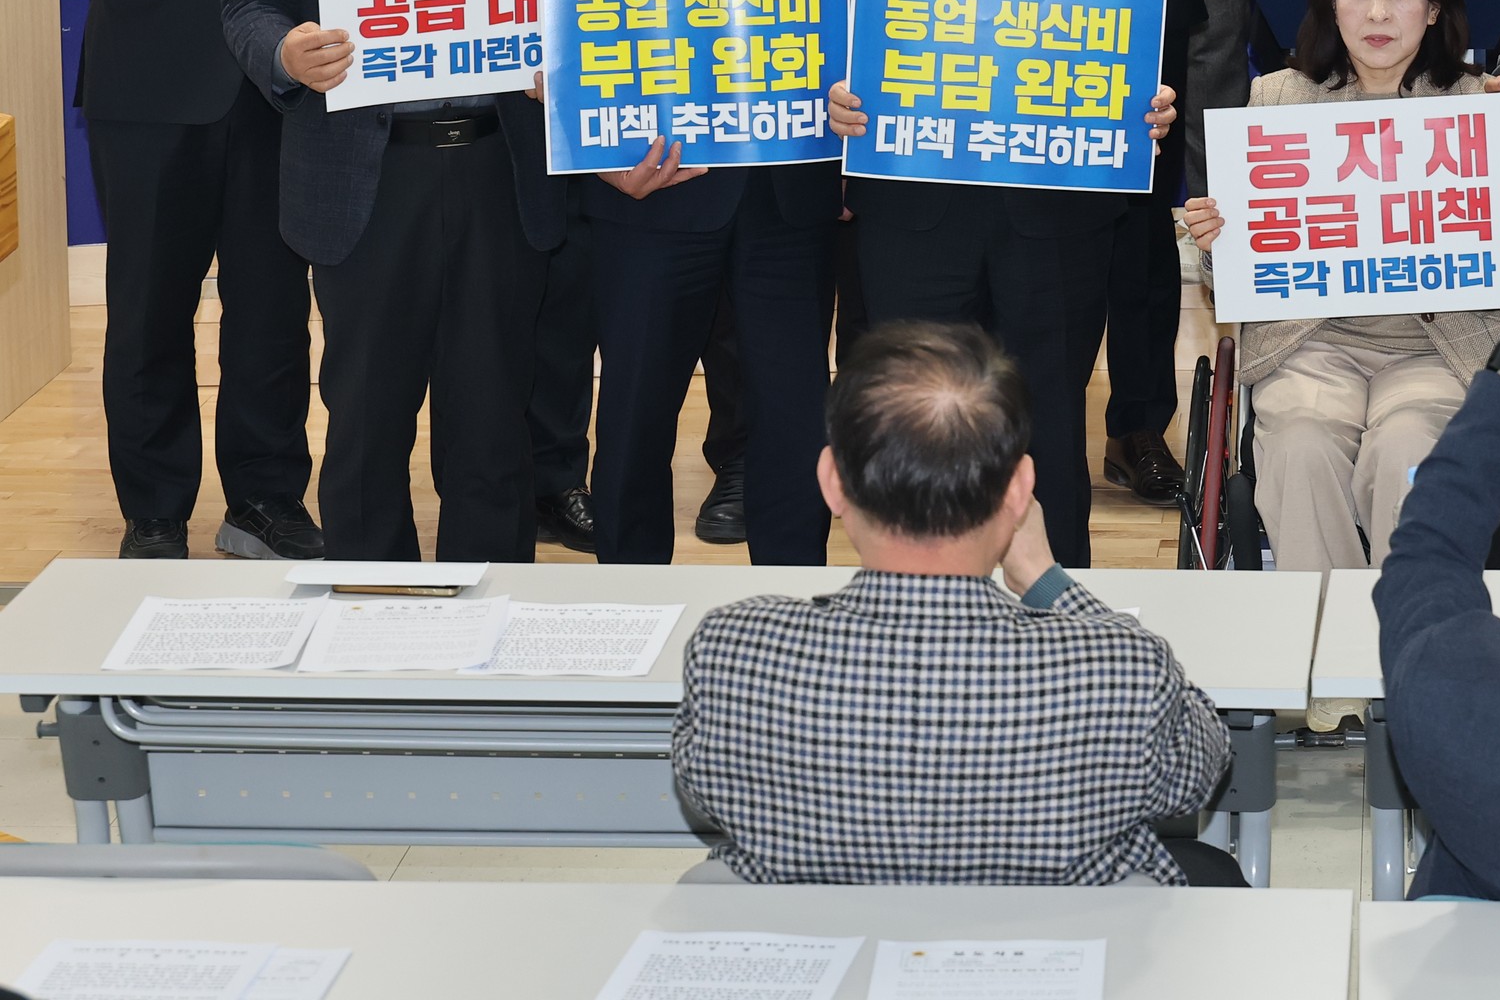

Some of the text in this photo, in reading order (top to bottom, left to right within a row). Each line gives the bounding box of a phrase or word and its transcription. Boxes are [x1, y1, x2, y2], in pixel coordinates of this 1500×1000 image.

[995, 2, 1131, 54] 생산비
[362, 43, 438, 82] 즉각
[580, 33, 825, 98] 부담 완화
[881, 49, 1131, 120] 부담 완화
[580, 99, 827, 147] 대책 추진하라
[875, 115, 1129, 169] 대책 추진하라
[1247, 186, 1493, 253] 공급 대책
[1254, 251, 1497, 299] 즉각 마련하라
